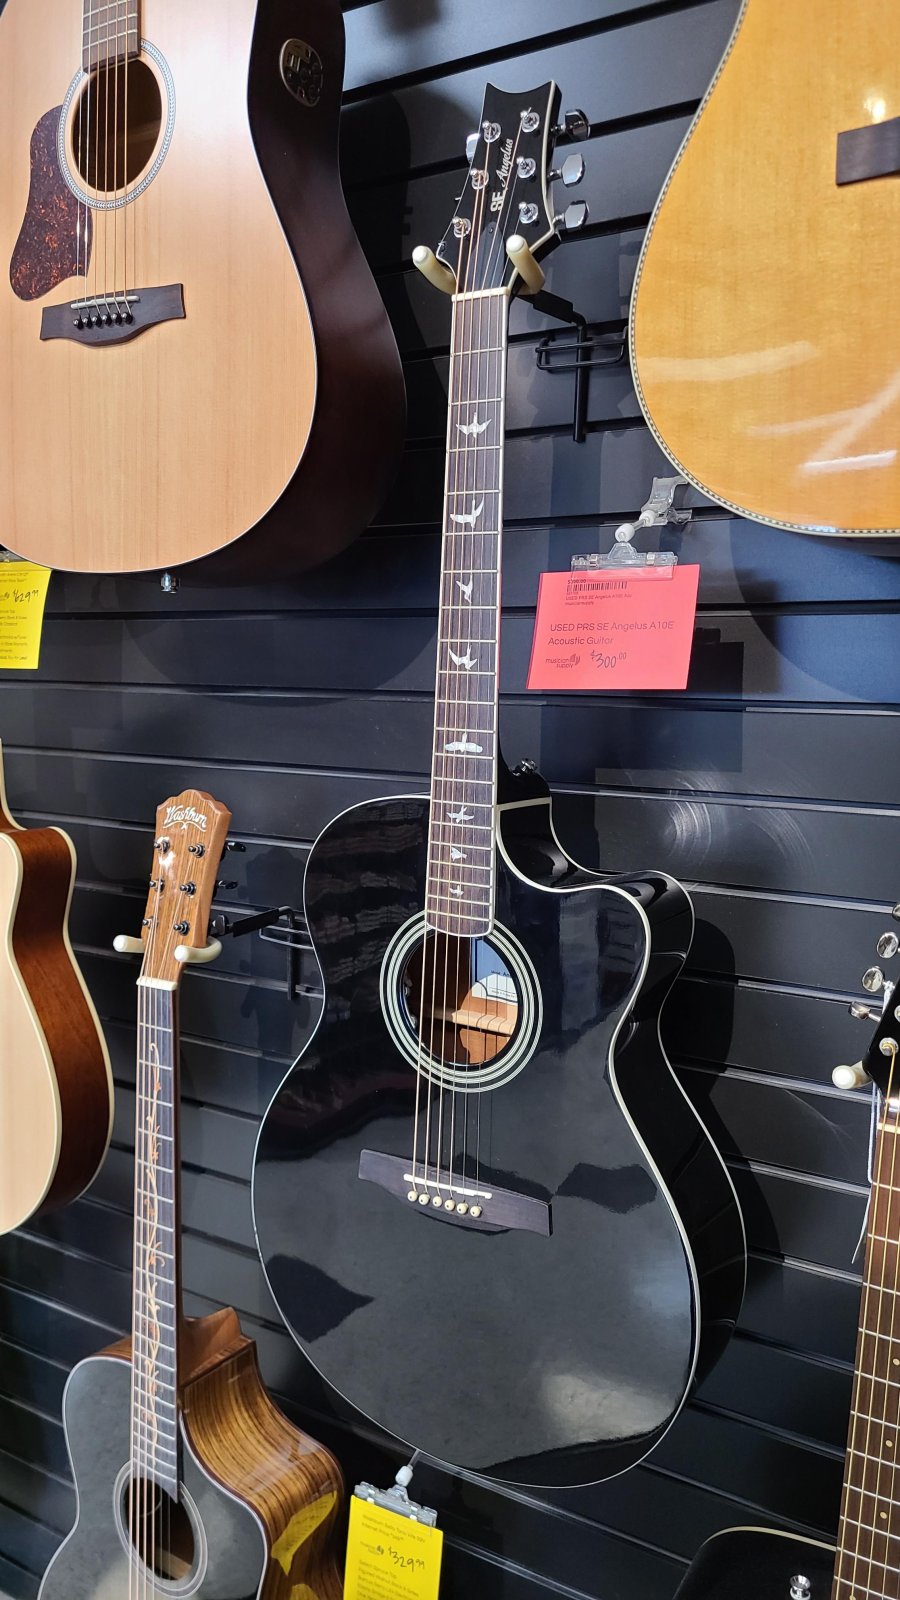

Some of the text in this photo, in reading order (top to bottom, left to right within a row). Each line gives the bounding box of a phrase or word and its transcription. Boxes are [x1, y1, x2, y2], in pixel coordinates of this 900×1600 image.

[490, 138, 513, 212] SE Angelus
[550, 621, 674, 632] USED PRS SE Angelus A10E
[548, 636, 614, 645] Acoustic Guitar
[164, 805, 207, 828] Washburn
